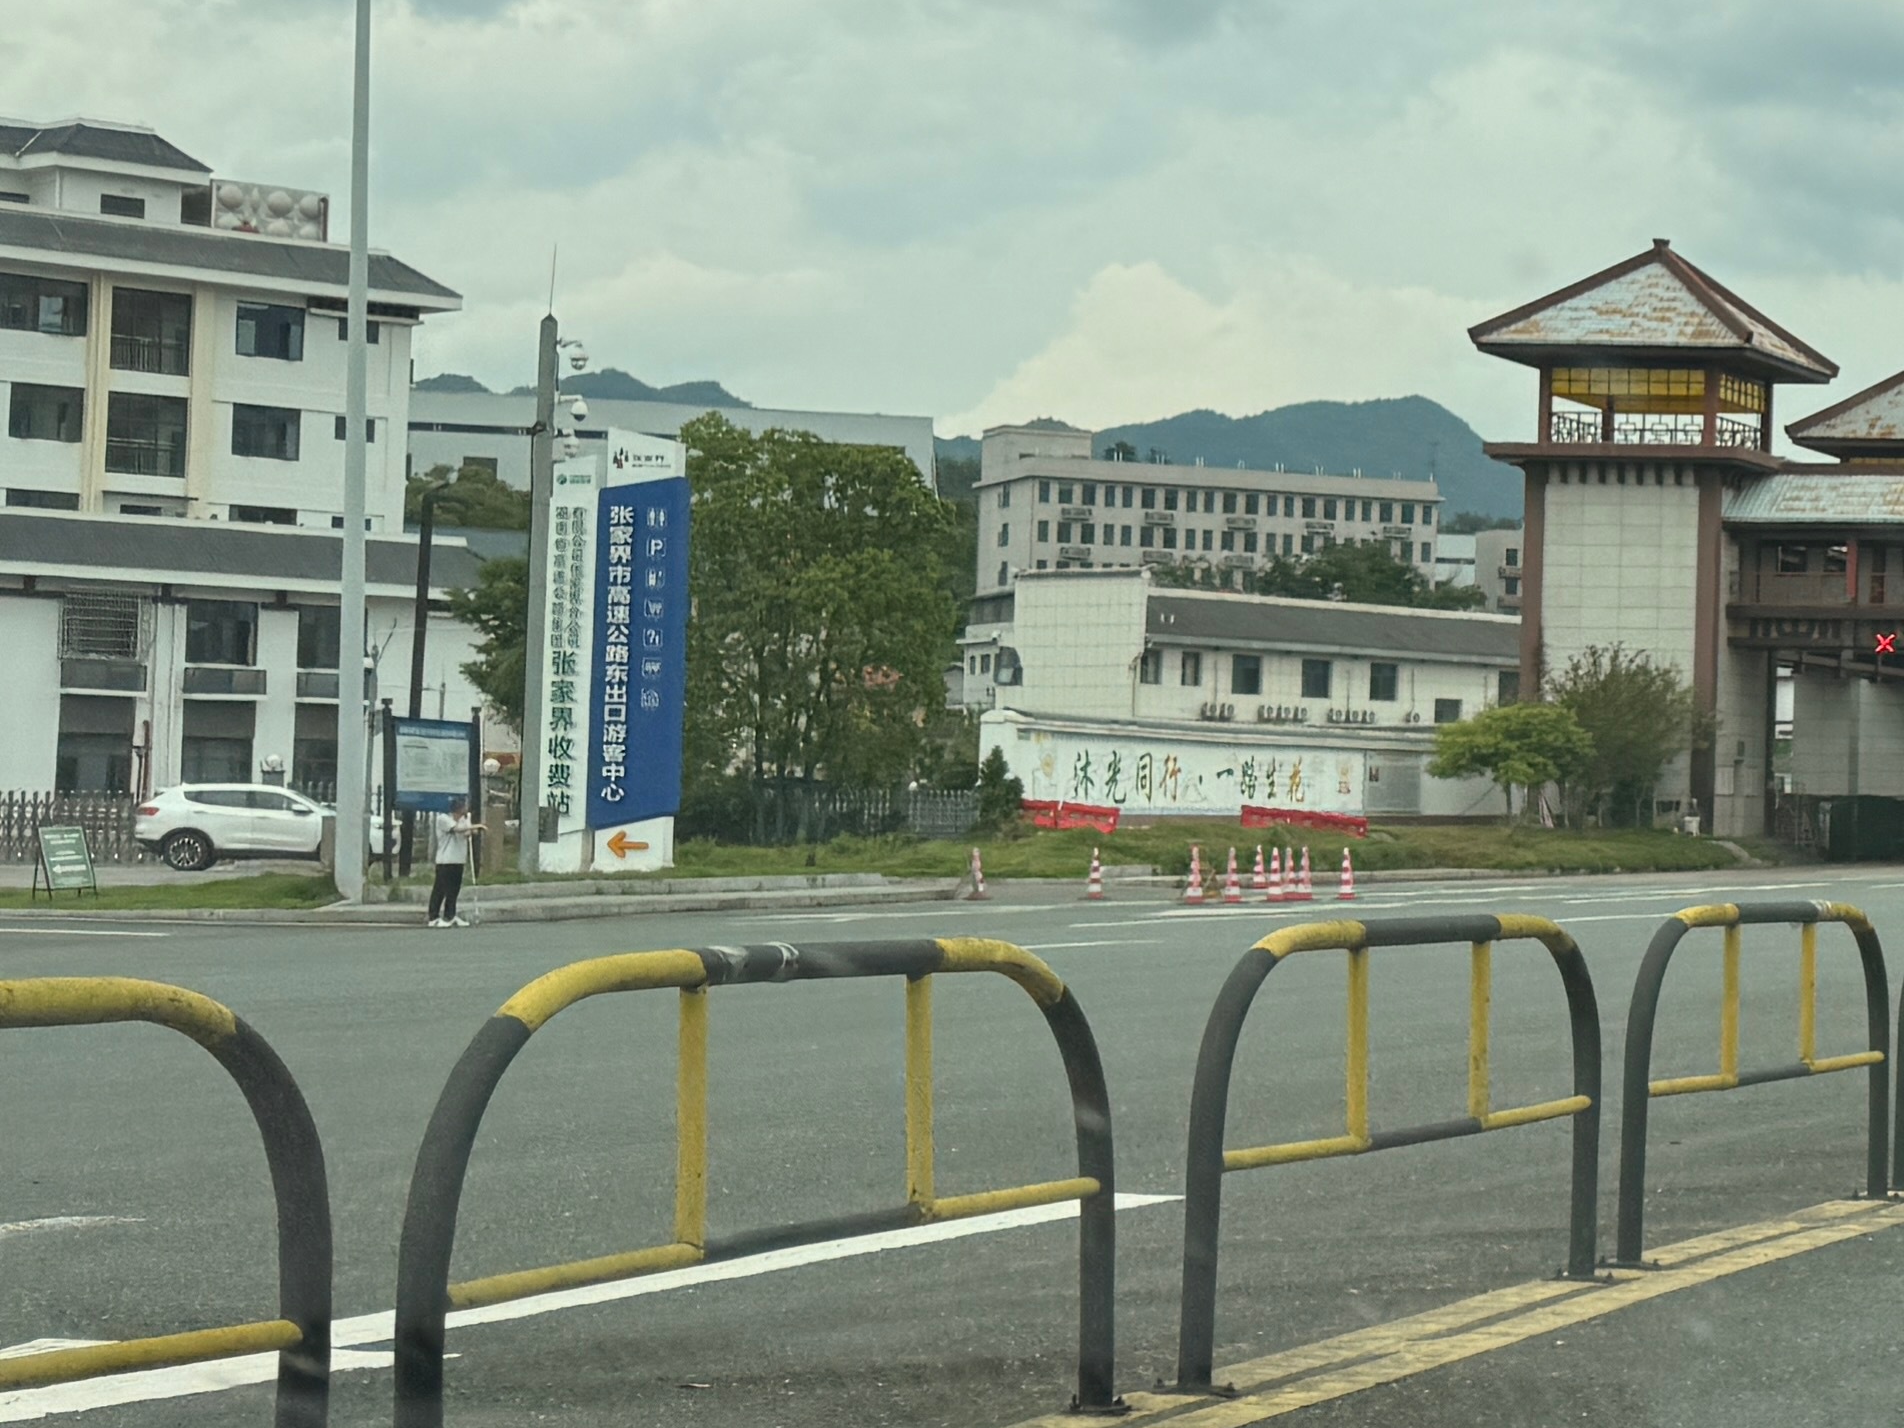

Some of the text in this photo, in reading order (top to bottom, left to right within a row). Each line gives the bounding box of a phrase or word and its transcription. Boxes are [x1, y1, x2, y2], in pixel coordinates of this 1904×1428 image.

[601, 505, 634, 802] 张家界市高速公路东出口游客中心
